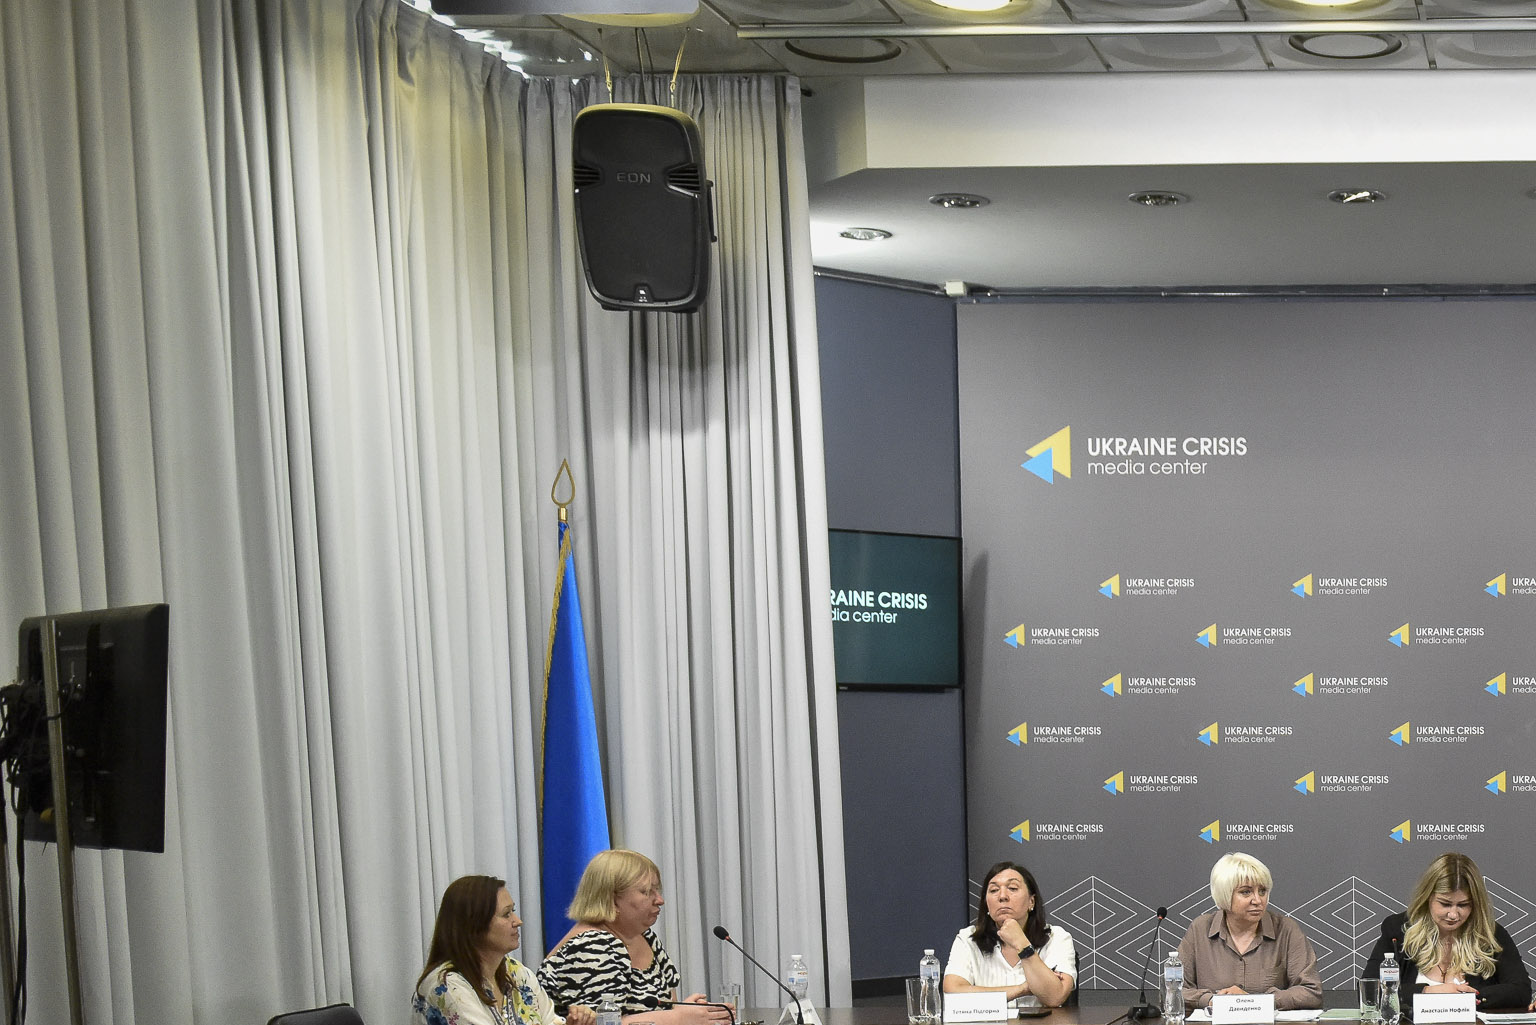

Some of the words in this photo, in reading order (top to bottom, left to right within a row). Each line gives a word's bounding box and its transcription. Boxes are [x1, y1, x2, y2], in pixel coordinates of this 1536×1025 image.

[616, 172, 651, 183] EON
[1087, 437, 1177, 457] UKRAINE
[1182, 436, 1248, 456] CRISIS
[1087, 458, 1145, 475] media
[1149, 458, 1208, 475] center
[1126, 578, 1165, 588] UKRAINE
[1166, 578, 1195, 588] CRISIS
[1318, 578, 1358, 587] UKRAINE
[1359, 577, 1388, 587] CRISIS
[1126, 587, 1152, 596] media
[1152, 587, 1178, 596] center
[1318, 587, 1344, 595] media
[1344, 587, 1371, 595] center
[830, 589, 875, 607] RAINE
[877, 591, 929, 610] CRISIS
[831, 608, 850, 622] dia
[852, 609, 898, 623] center
[1031, 628, 1070, 637] UKRAINE
[1071, 627, 1100, 637] CRISIS
[1223, 627, 1262, 637] UKRAINE
[1263, 627, 1292, 637] CRISIS
[1415, 627, 1455, 637] UKRAINE
[1455, 627, 1485, 637] CRISIS
[1031, 637, 1057, 645] media
[1057, 637, 1083, 645] center
[1223, 637, 1249, 645] media
[1249, 637, 1275, 645] center
[1415, 636, 1441, 644] media
[1441, 636, 1468, 644] center
[1128, 677, 1167, 687] UKRAINE
[1168, 677, 1197, 687] CRISIS
[1319, 677, 1359, 686] UKRAINE
[1359, 677, 1389, 686] CRISIS
[1128, 686, 1154, 694] media
[1154, 686, 1179, 694] center
[1319, 686, 1345, 694] media
[1345, 686, 1372, 694] center
[1033, 726, 1072, 736] UKRAINE
[1073, 726, 1102, 736] CRISIS
[1224, 726, 1263, 736] UKRAINE
[1264, 726, 1293, 736] CRISIS
[1416, 726, 1455, 735] UKRAINE
[1456, 726, 1485, 735] CRISIS
[1033, 735, 1059, 743] media
[1059, 735, 1085, 743] center
[1224, 735, 1250, 743] media
[1250, 735, 1276, 743] center
[1416, 735, 1442, 743] media
[1442, 735, 1468, 743] center
[1130, 775, 1169, 785] UKRAINE
[1169, 775, 1198, 785] CRISIS
[1320, 775, 1360, 784] UKRAINE
[1360, 775, 1389, 784] CRISIS
[1130, 784, 1155, 792] media
[1155, 784, 1181, 792] center
[1320, 784, 1346, 792] media
[1346, 784, 1372, 792] center
[1036, 823, 1075, 833] UKRAINE
[1075, 823, 1104, 833] CRISIS
[1226, 824, 1265, 833] UKRAINE
[1265, 824, 1294, 833] CRISIS
[1416, 823, 1456, 833] UKRAINE
[1456, 823, 1485, 833] CRISIS
[1036, 833, 1061, 841] media
[1061, 833, 1087, 841] center
[1226, 833, 1251, 841] media
[1251, 833, 1278, 841] center
[1416, 833, 1442, 841] media
[1442, 833, 1468, 841] center
